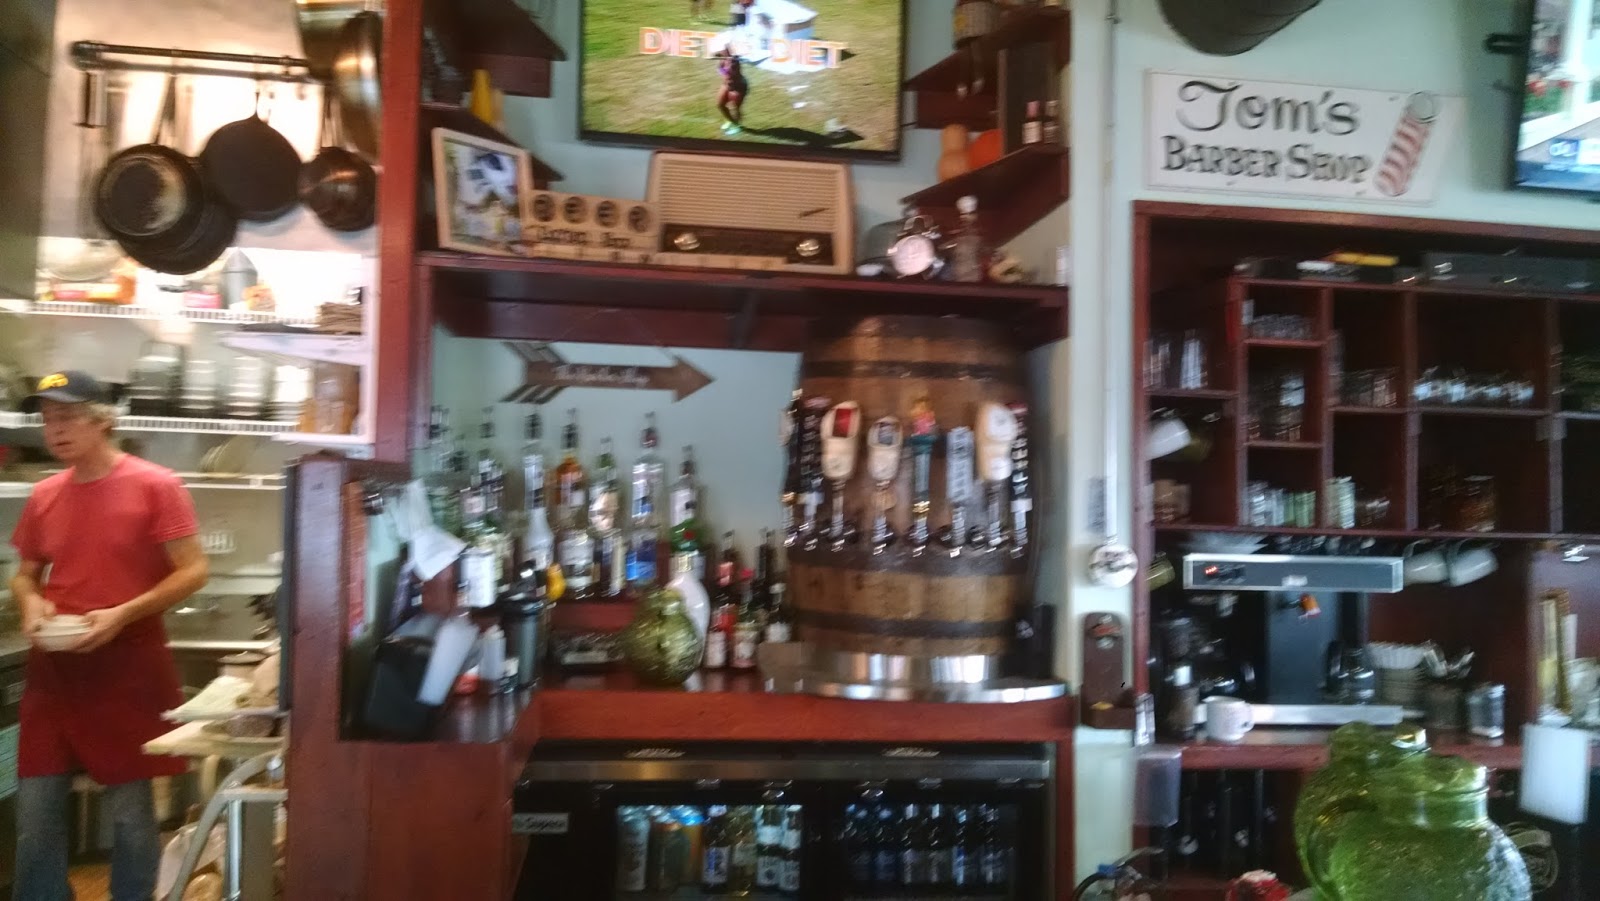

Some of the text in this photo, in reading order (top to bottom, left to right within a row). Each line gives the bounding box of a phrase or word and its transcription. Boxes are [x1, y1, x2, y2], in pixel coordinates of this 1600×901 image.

[769, 37, 850, 69] DIET
[1176, 80, 1361, 135] Tom's
[1161, 135, 1280, 178] BARBER
